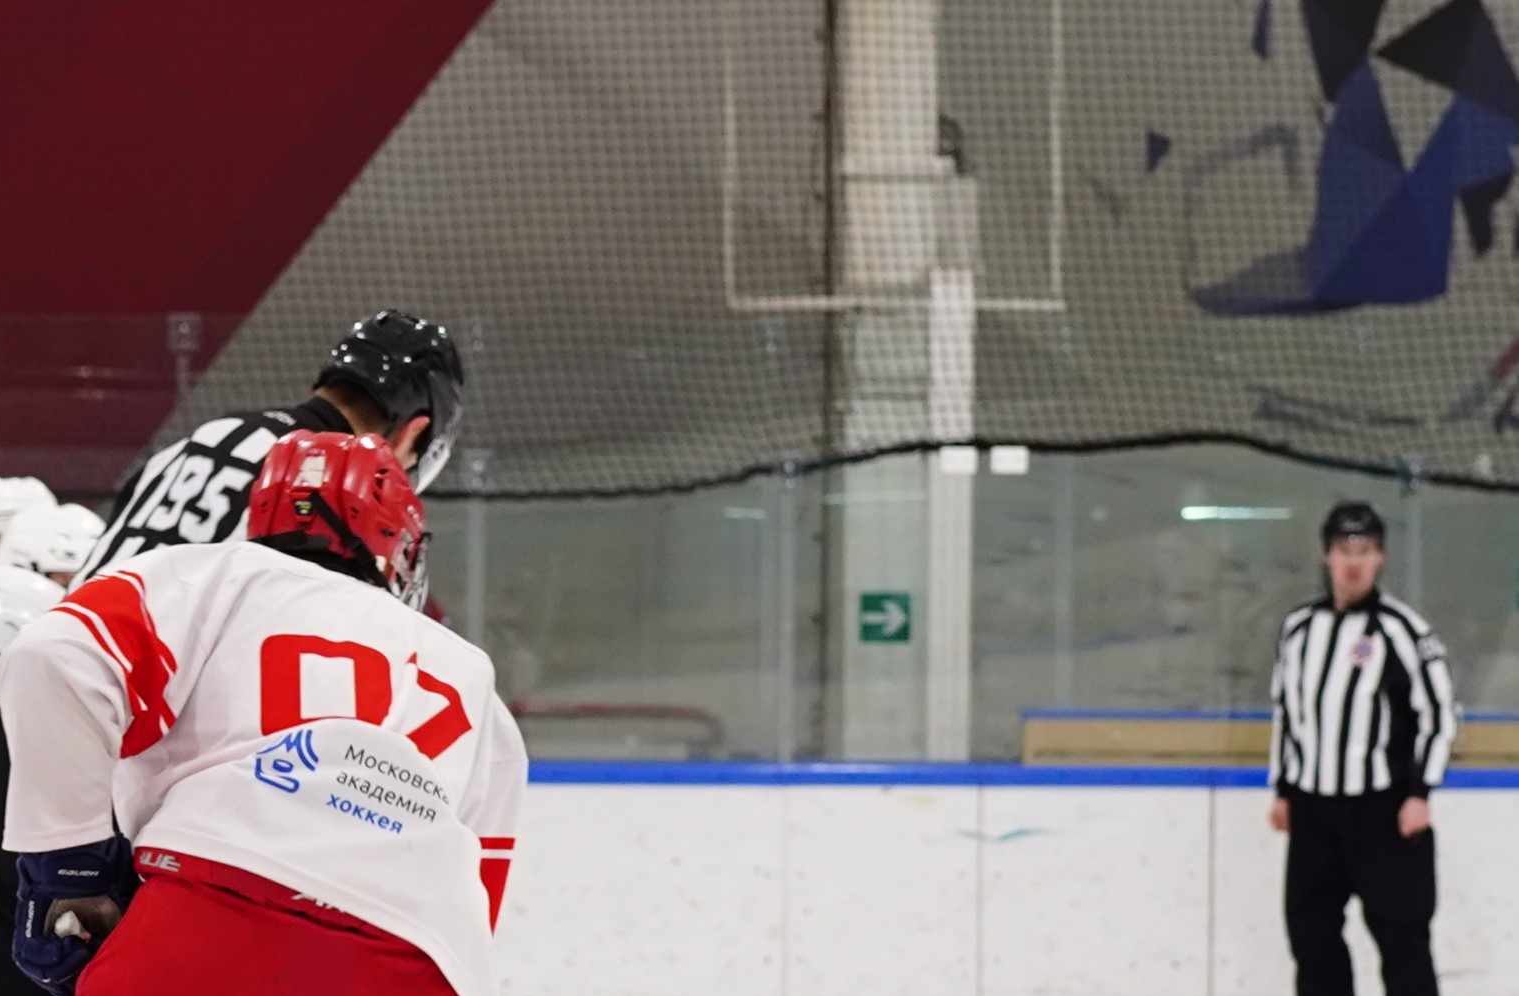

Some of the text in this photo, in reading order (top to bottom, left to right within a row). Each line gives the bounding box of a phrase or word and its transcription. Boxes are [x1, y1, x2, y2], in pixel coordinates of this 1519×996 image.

[126, 453, 255, 543] 195
[326, 793, 403, 834] хоккея
[336, 771, 437, 822] академия
